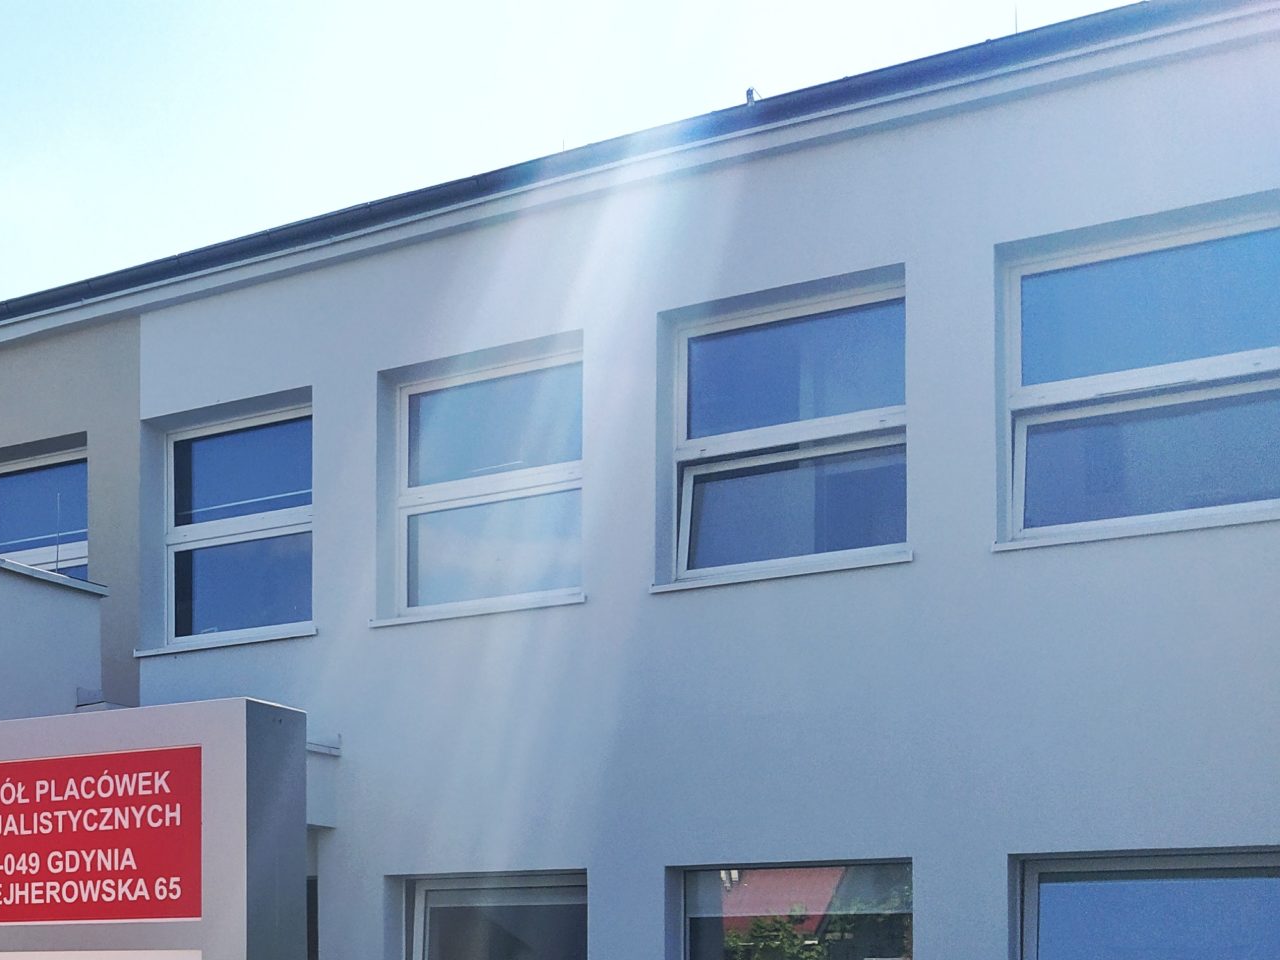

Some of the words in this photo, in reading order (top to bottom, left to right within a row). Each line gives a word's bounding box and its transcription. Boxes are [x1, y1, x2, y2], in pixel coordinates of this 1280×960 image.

[35, 770, 171, 802] PLACÓWEK
[47, 848, 137, 874] GDYNIA
[154, 877, 182, 900] 65
